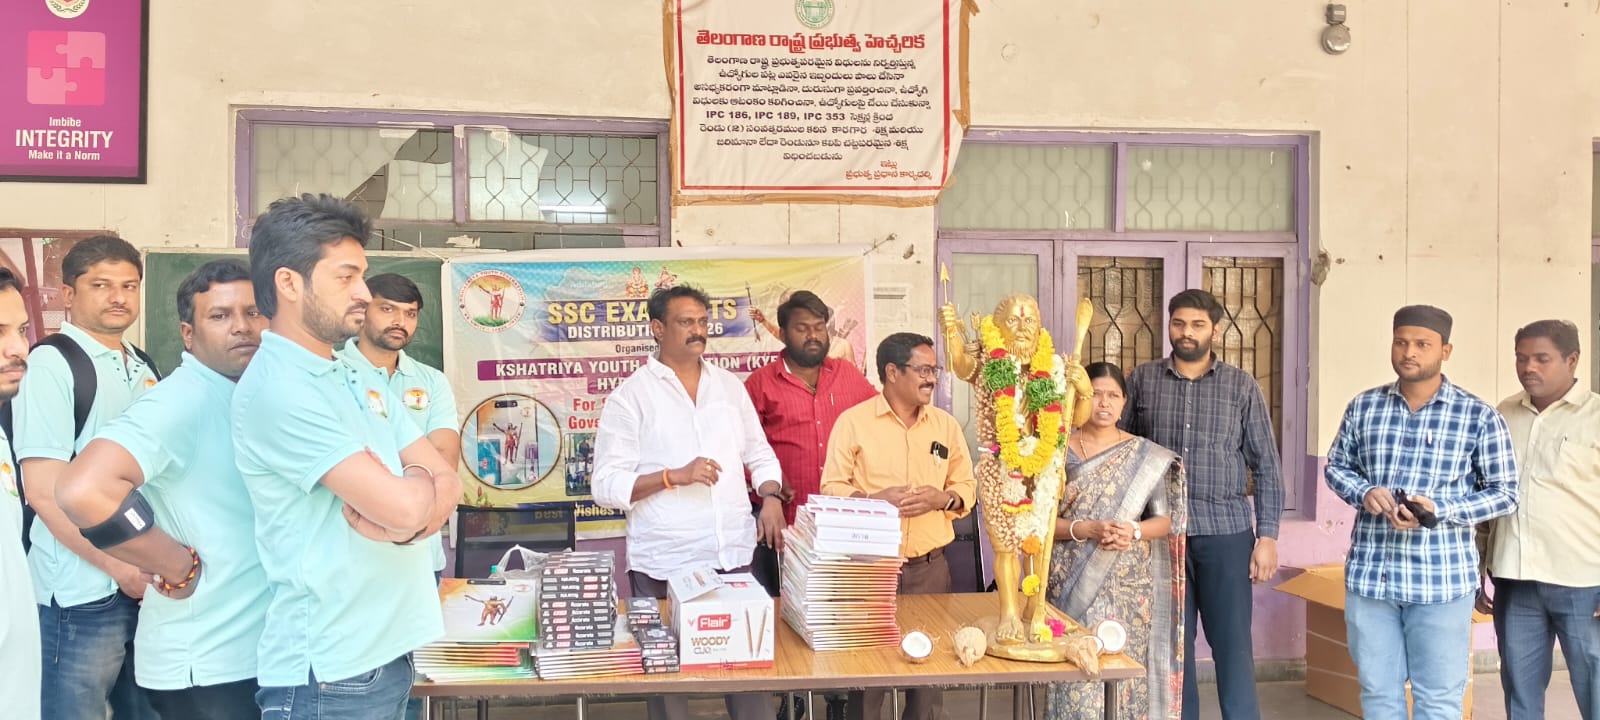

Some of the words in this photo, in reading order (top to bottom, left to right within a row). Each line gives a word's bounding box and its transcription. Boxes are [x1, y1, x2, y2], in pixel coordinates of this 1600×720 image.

[696, 30, 766, 46] తెలంగాణ
[769, 33, 806, 53] రాష్ట్ర
[809, 33, 861, 52] ప్రభుత్వ
[865, 34, 925, 53] హెచ్చరిక
[707, 56, 748, 65] తెలంగాణ
[749, 58, 769, 69] రాష్ట్ర
[719, 69, 759, 81] ఉద్యోగుల
[49, 116, 82, 127] Imbibe
[706, 110, 725, 119] IPC
[728, 111, 751, 120] 186,
[755, 112, 774, 120] IPC
[777, 112, 800, 120] 189,
[803, 112, 822, 121] IPC
[825, 112, 846, 121] 353
[699, 123, 726, 132] రెండు
[889, 126, 924, 134] మరియు
[15, 129, 113, 149] INTEGRITY
[759, 137, 778, 146] లేదా
[28, 149, 54, 160] Make
[57, 149, 63, 160] it
[66, 152, 71, 160] a
[74, 150, 100, 161] Norm
[547, 302, 596, 325] SSC
[606, 301, 650, 322] EXA
[567, 324, 653, 339] DISTRIBUTI
[495, 361, 583, 377] KSHATRIYA
[588, 359, 640, 374] YOUTH
[573, 398, 596, 412] For
[700, 616, 730, 629] Flair
[691, 635, 731, 647] WOODY
